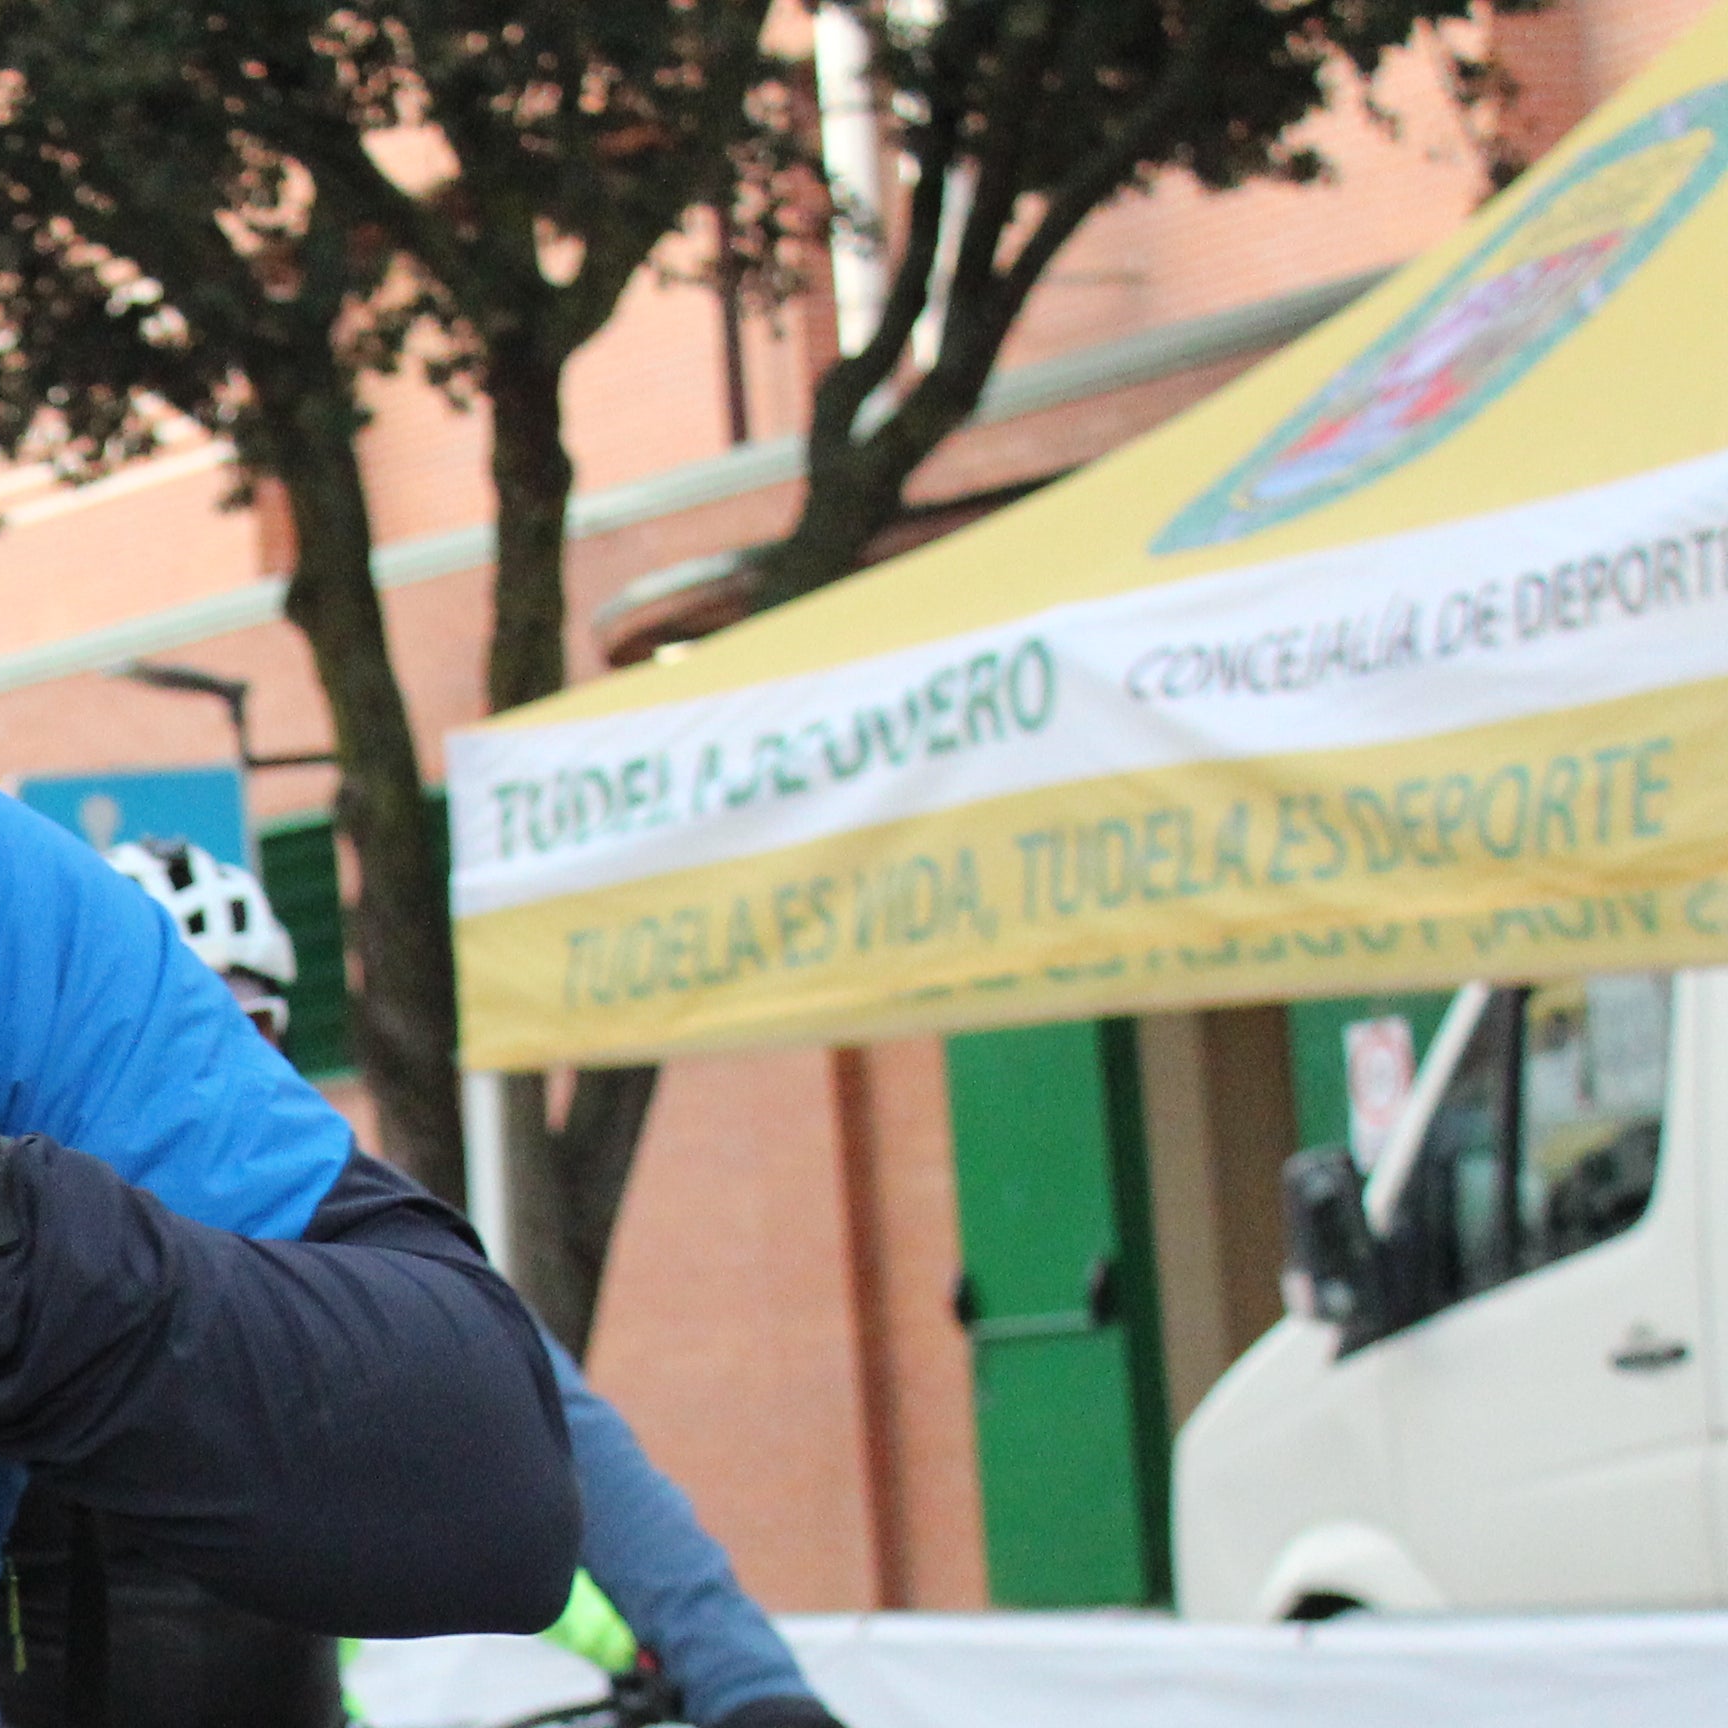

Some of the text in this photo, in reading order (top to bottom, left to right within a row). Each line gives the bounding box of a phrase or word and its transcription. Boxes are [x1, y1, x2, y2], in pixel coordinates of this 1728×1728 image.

[1436, 582, 1504, 658] DE
[565, 896, 768, 1008] TUDELA
[773, 873, 840, 968] ES
[1013, 800, 1255, 922] TUDELA
[1267, 792, 1348, 884] ES
[1346, 736, 1676, 876] DEPORTE
